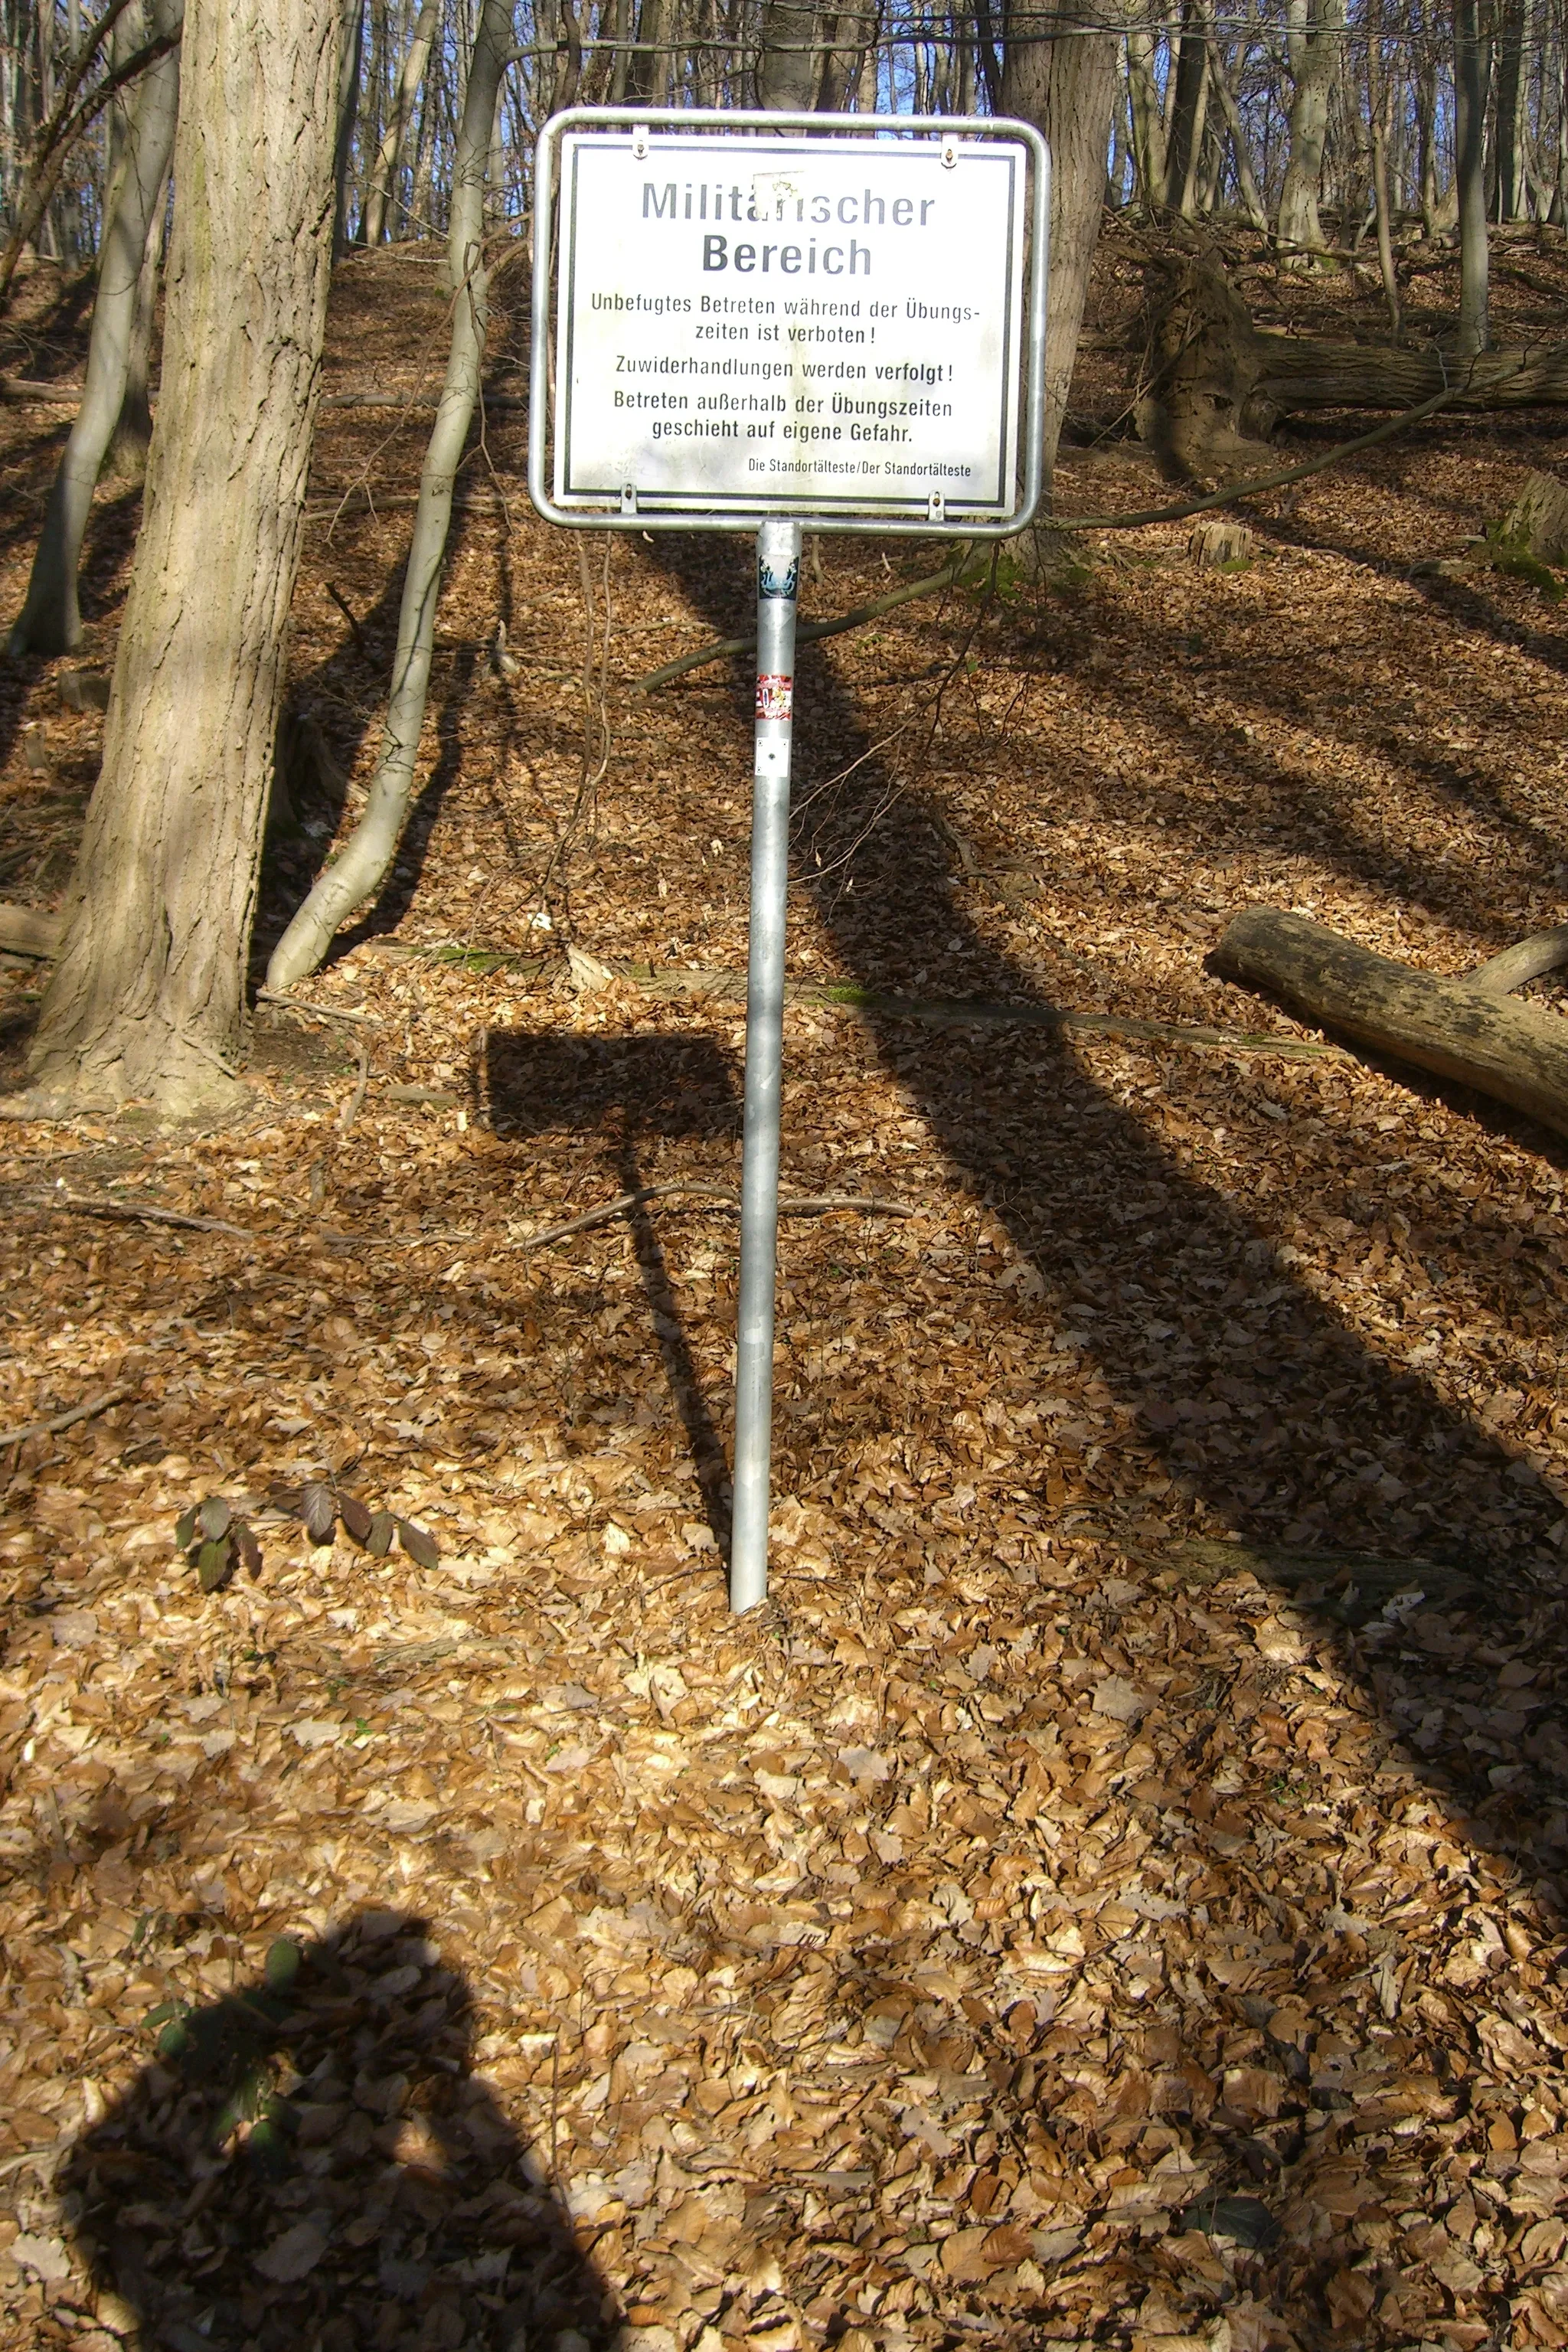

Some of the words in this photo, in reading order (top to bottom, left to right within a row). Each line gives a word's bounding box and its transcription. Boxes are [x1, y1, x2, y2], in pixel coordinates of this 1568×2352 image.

[703, 234, 871, 276] Bereich
[591, 292, 691, 315] Unbefugtes
[701, 295, 775, 315] Betreten
[784, 298, 861, 317] während
[869, 300, 898, 318] der
[906, 297, 980, 324] Übungs-
[695, 322, 749, 340] zeiten
[758, 323, 780, 341] ist
[616, 354, 793, 381] Zuwiderhandlungen
[802, 361, 866, 379] werden
[614, 390, 688, 410] Betreten
[697, 393, 786, 413] außerhalb
[795, 394, 825, 413] der
[831, 391, 952, 420] Übungszeiten
[652, 418, 739, 439] geschieht
[746, 420, 776, 439] auf
[782, 420, 842, 444] eigene
[850, 423, 913, 443] Gefahr.
[748, 458, 766, 472] Die
[884, 461, 972, 478] Standortälteste
